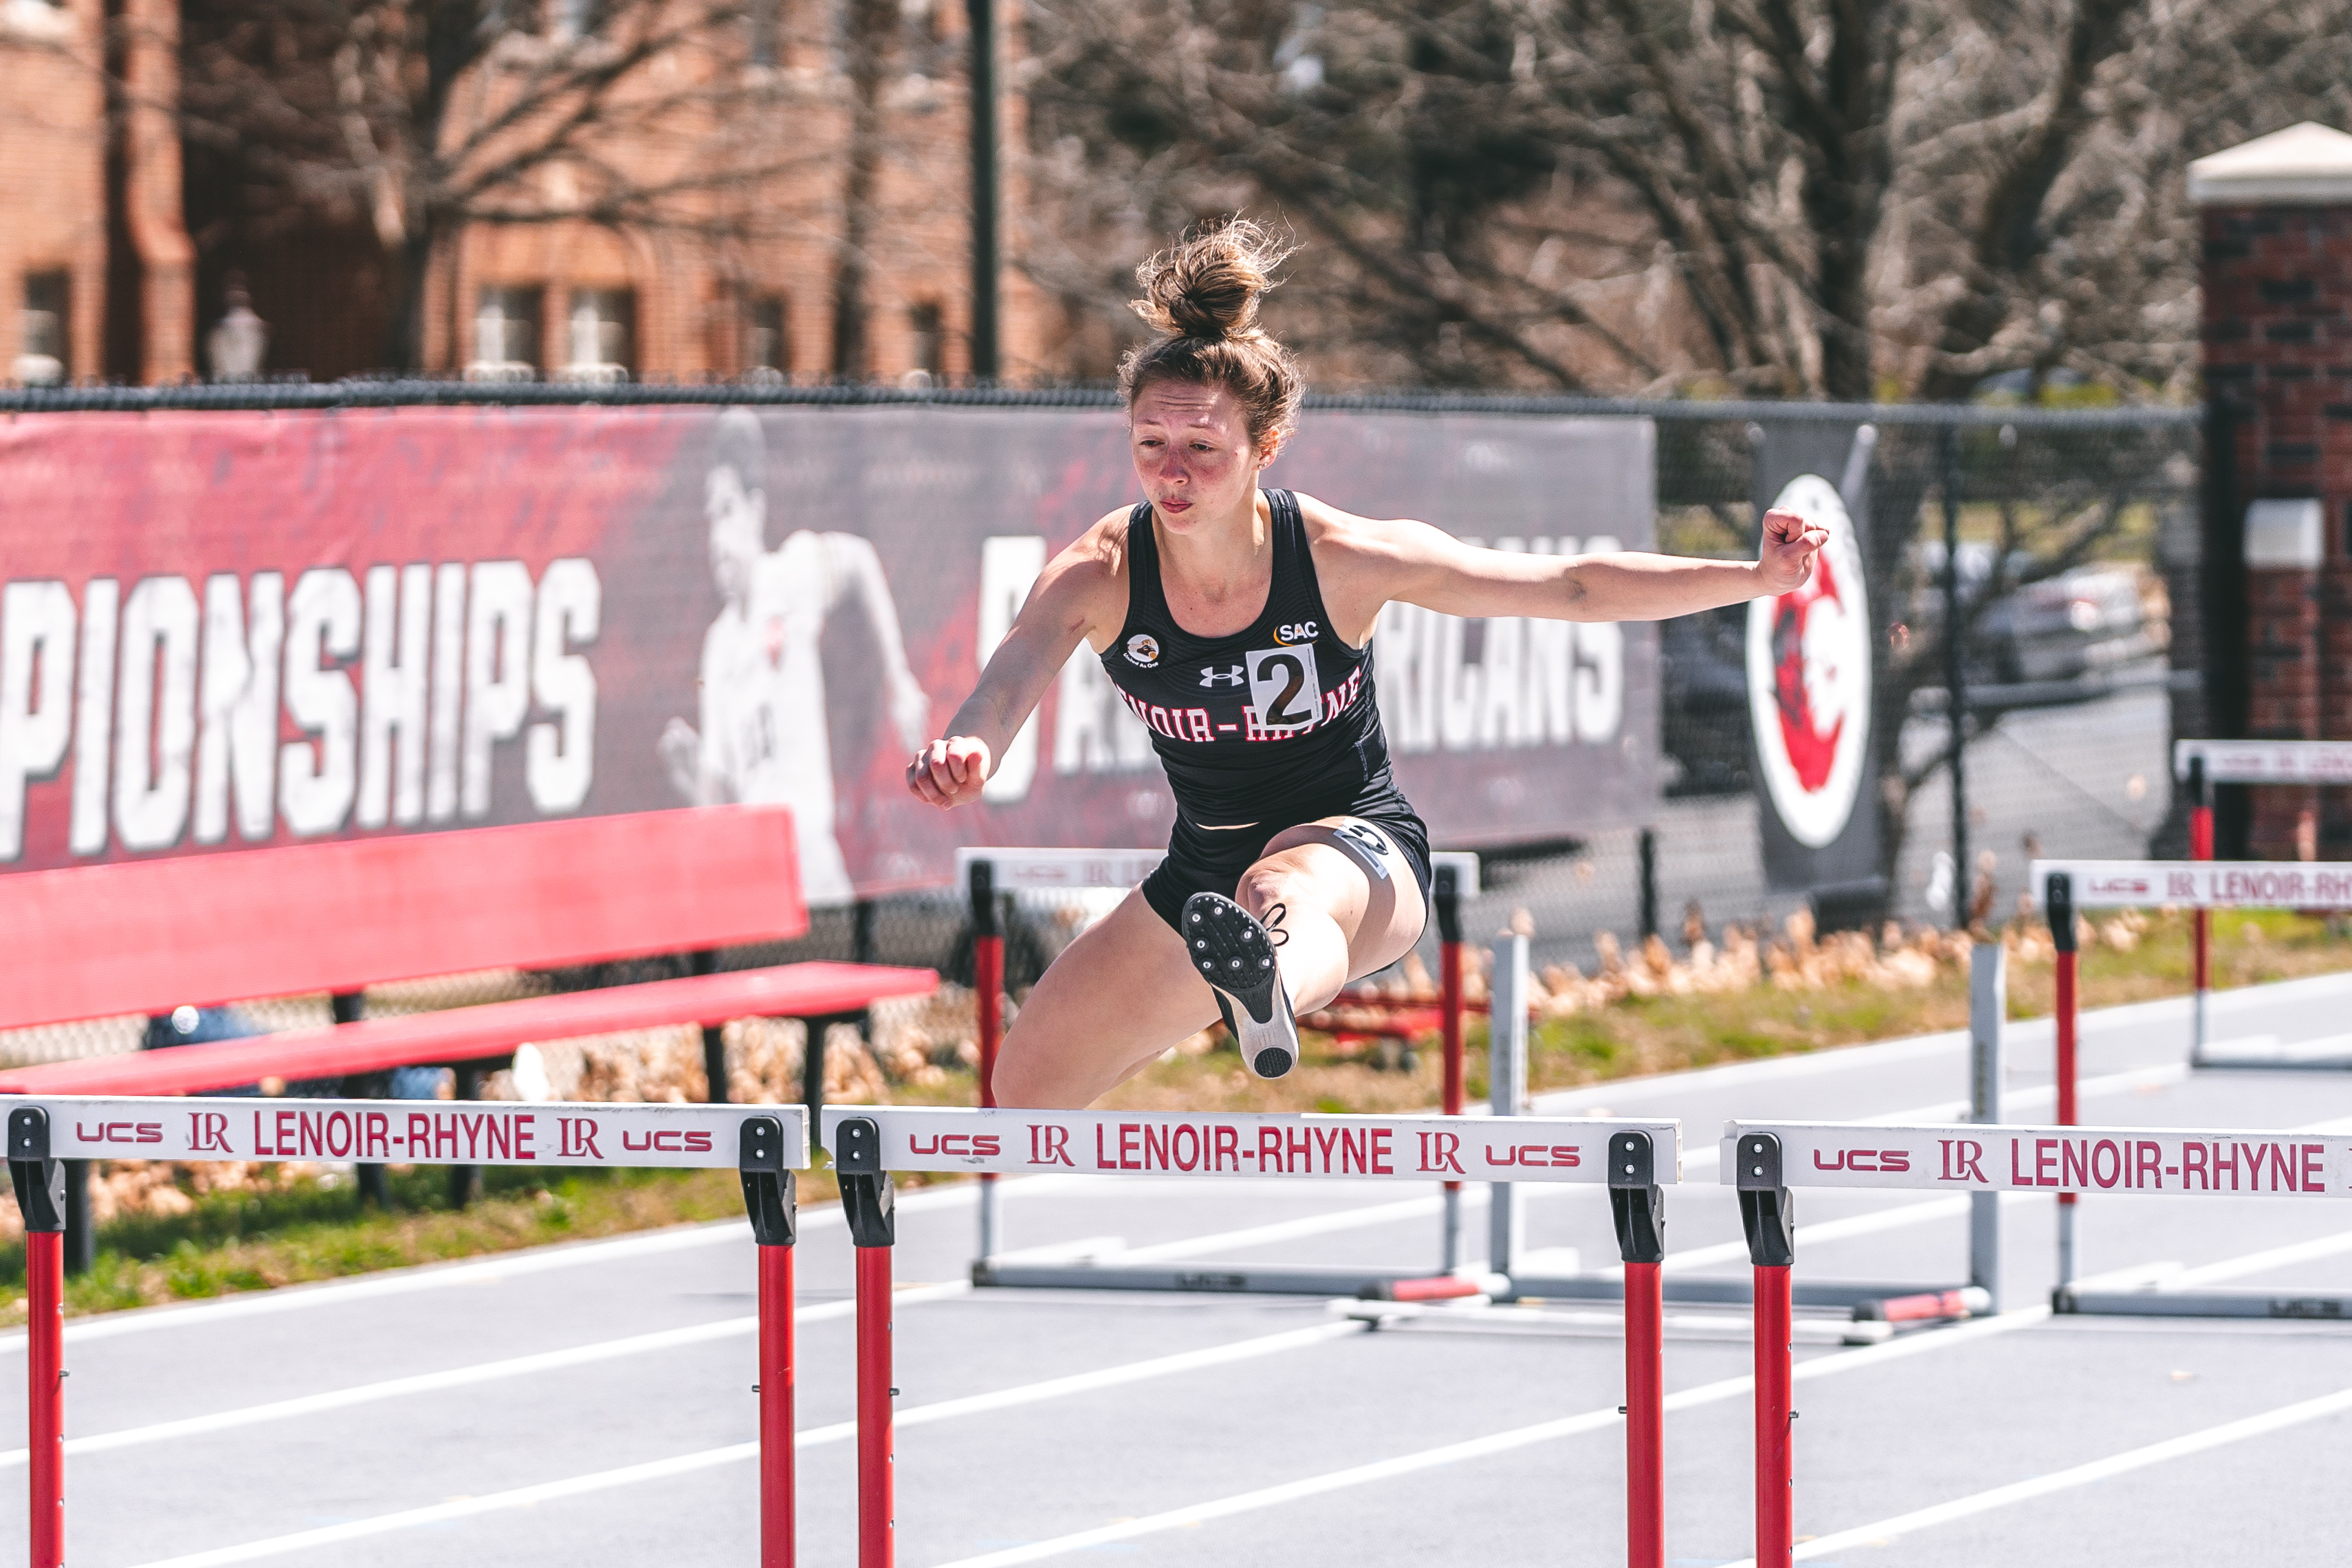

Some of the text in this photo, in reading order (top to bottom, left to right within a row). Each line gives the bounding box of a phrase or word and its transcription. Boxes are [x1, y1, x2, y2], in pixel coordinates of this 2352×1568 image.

[1279, 621, 1319, 641] SAC
[0, 555, 601, 863] PIONSHIPS
[1257, 654, 1312, 726] 2
[2210, 870, 2352, 901] LENOIR-RH
[77, 1109, 712, 1160] UCS LR LENOIR-RHYNE LR UCS
[910, 1123, 1580, 1175] UCS LR LENOIR-RHYNE LR UCS
[1814, 1149, 1909, 1171] UCS
[1937, 1139, 1990, 1183] LR
[2011, 1138, 2325, 1192] LENOIR-RHYNE
